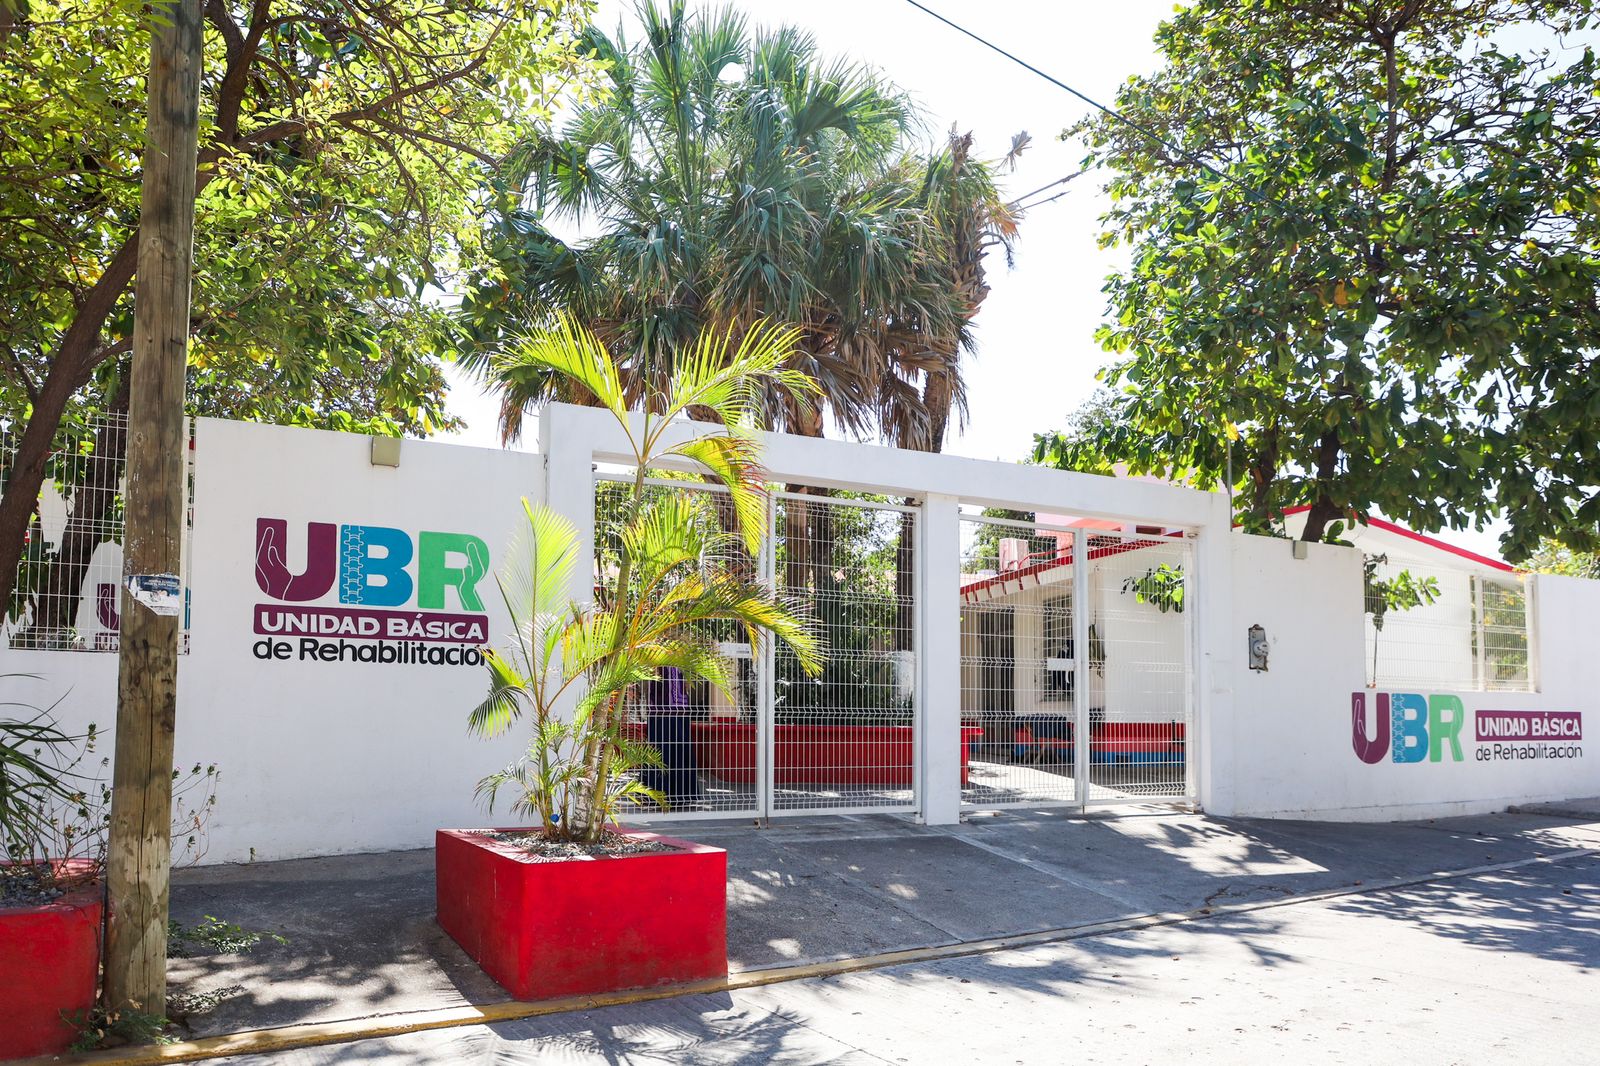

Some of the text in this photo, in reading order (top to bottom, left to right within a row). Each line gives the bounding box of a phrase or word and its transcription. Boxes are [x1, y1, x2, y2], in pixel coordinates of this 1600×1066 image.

[254, 517, 490, 612] UBR
[261, 611, 485, 640] UNIDAD BÁSICA
[252, 637, 293, 661] de
[1351, 691, 1465, 765] UBR
[1477, 712, 1581, 737] UNIDAD BÁSICA
[1475, 742, 1583, 761] de Rehabilitación
